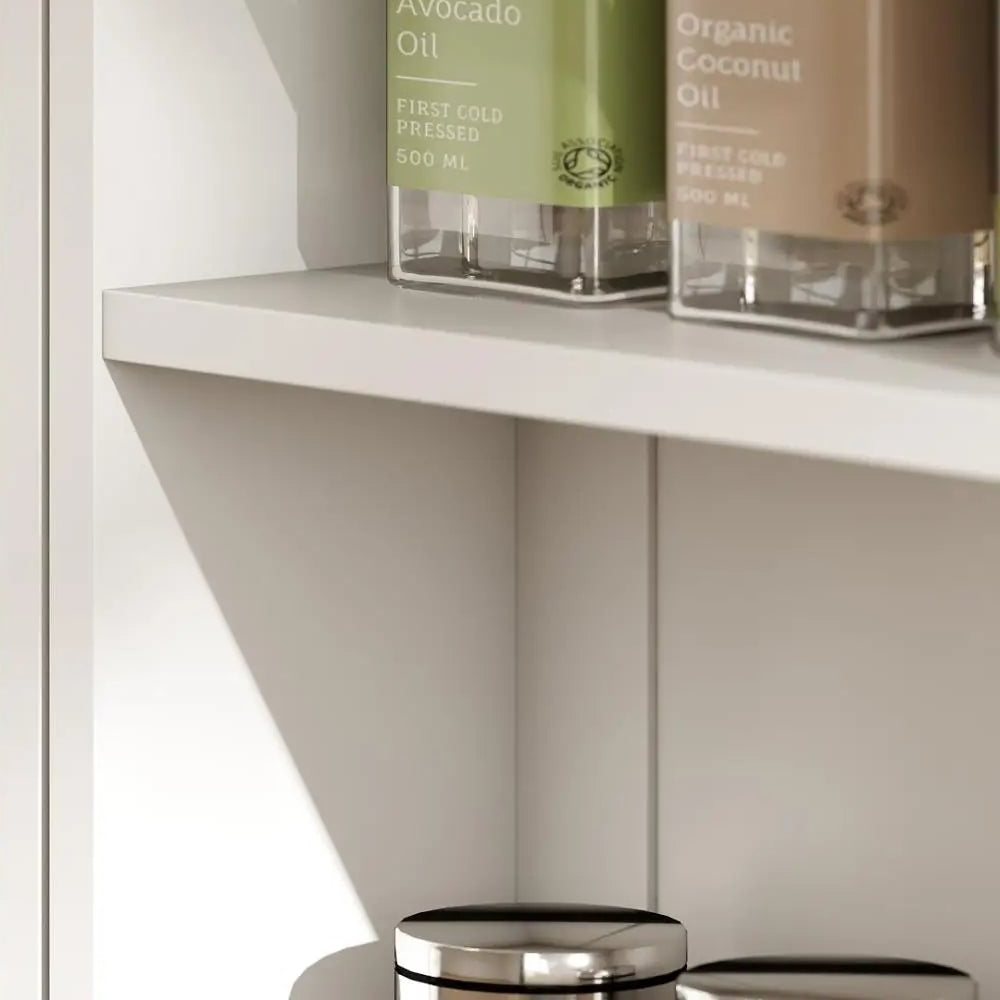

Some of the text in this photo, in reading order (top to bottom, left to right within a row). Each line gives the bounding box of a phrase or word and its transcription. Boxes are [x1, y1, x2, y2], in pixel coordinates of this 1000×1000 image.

[677, 12, 794, 47] Organic
[397, 30, 439, 59] Oil
[677, 46, 802, 83] Coconut
[677, 82, 720, 110] Oil
[396, 98, 504, 124] FIRST COLD
[396, 119, 480, 142] PRESSED
[396, 148, 470, 171] 500 ML
